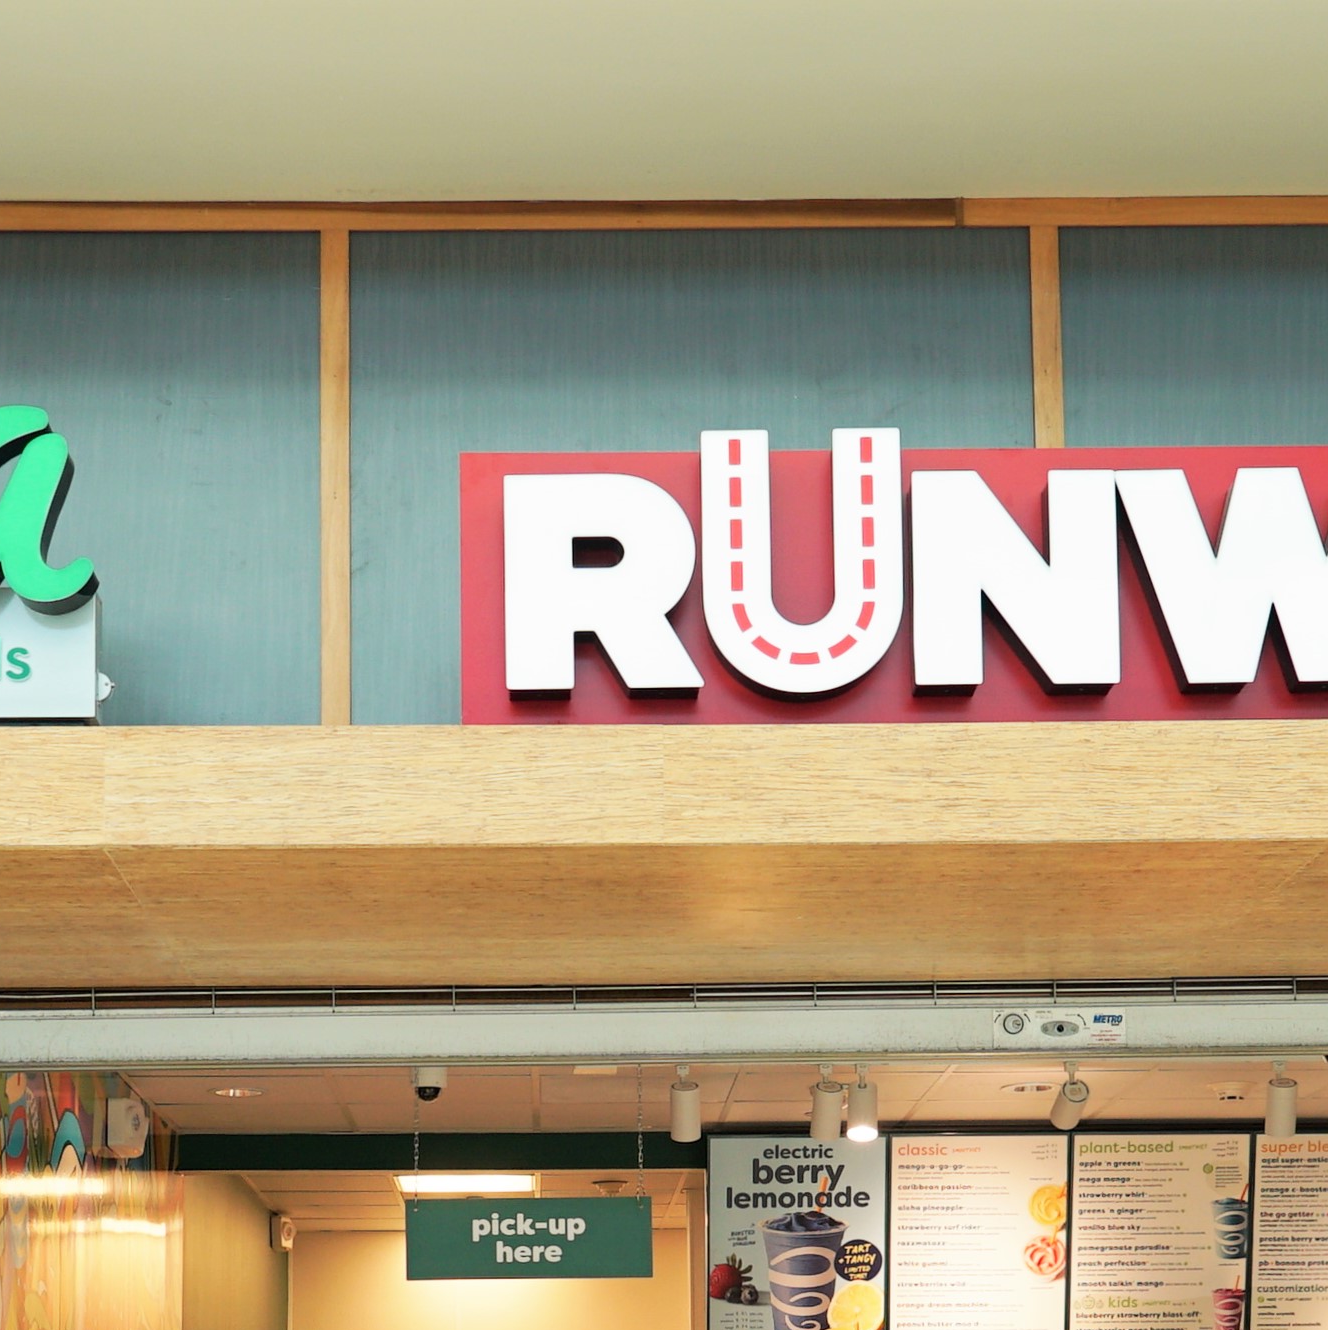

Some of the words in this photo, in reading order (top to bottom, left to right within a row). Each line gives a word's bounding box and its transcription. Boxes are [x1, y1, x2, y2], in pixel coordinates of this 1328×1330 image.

[1093, 1014, 1123, 1024] METRO
[763, 1145, 833, 1159] electric
[898, 1143, 948, 1156] classic
[1079, 1141, 1174, 1156] plant-based
[1261, 1143, 1303, 1156] super
[752, 1158, 845, 1190] berry
[726, 1186, 870, 1209] lemonade
[472, 1213, 586, 1242] pick-up
[496, 1241, 563, 1263] here
[844, 1243, 871, 1255] TART
[844, 1265, 871, 1274] LIMITED
[1108, 1296, 1138, 1308] kids
